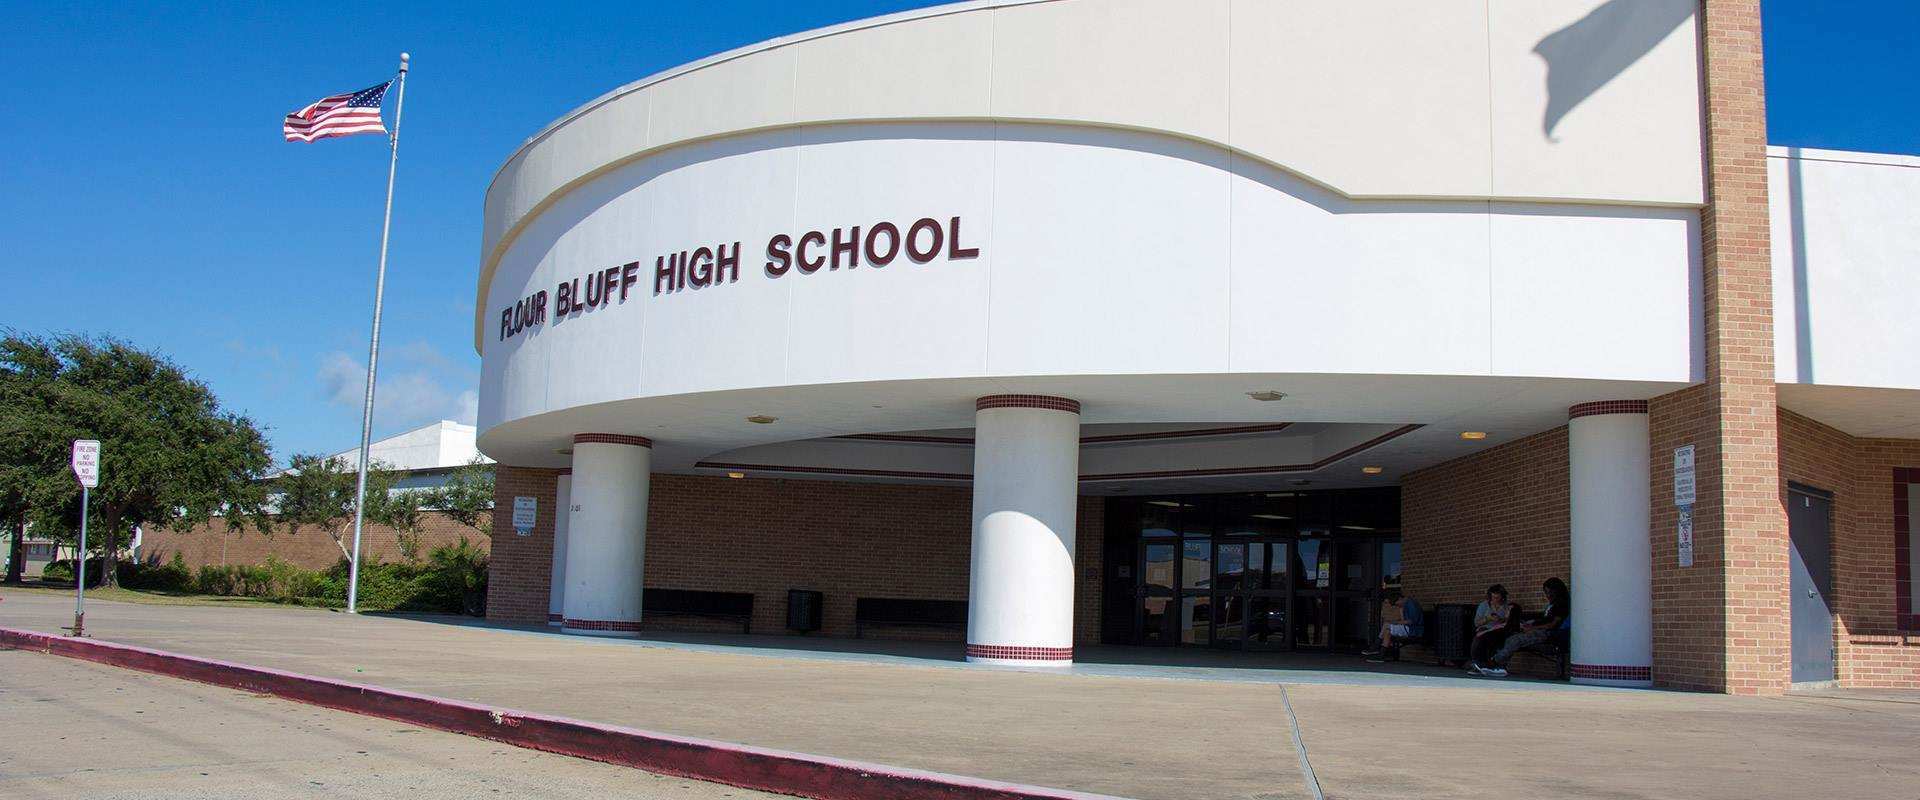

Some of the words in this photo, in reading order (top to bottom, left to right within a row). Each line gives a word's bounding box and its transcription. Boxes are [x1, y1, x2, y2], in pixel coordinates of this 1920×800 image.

[499, 289, 548, 341] FLOUR
[556, 261, 640, 318] BLUFF
[655, 241, 741, 295] HIGH
[765, 216, 980, 277] SCHOOL
